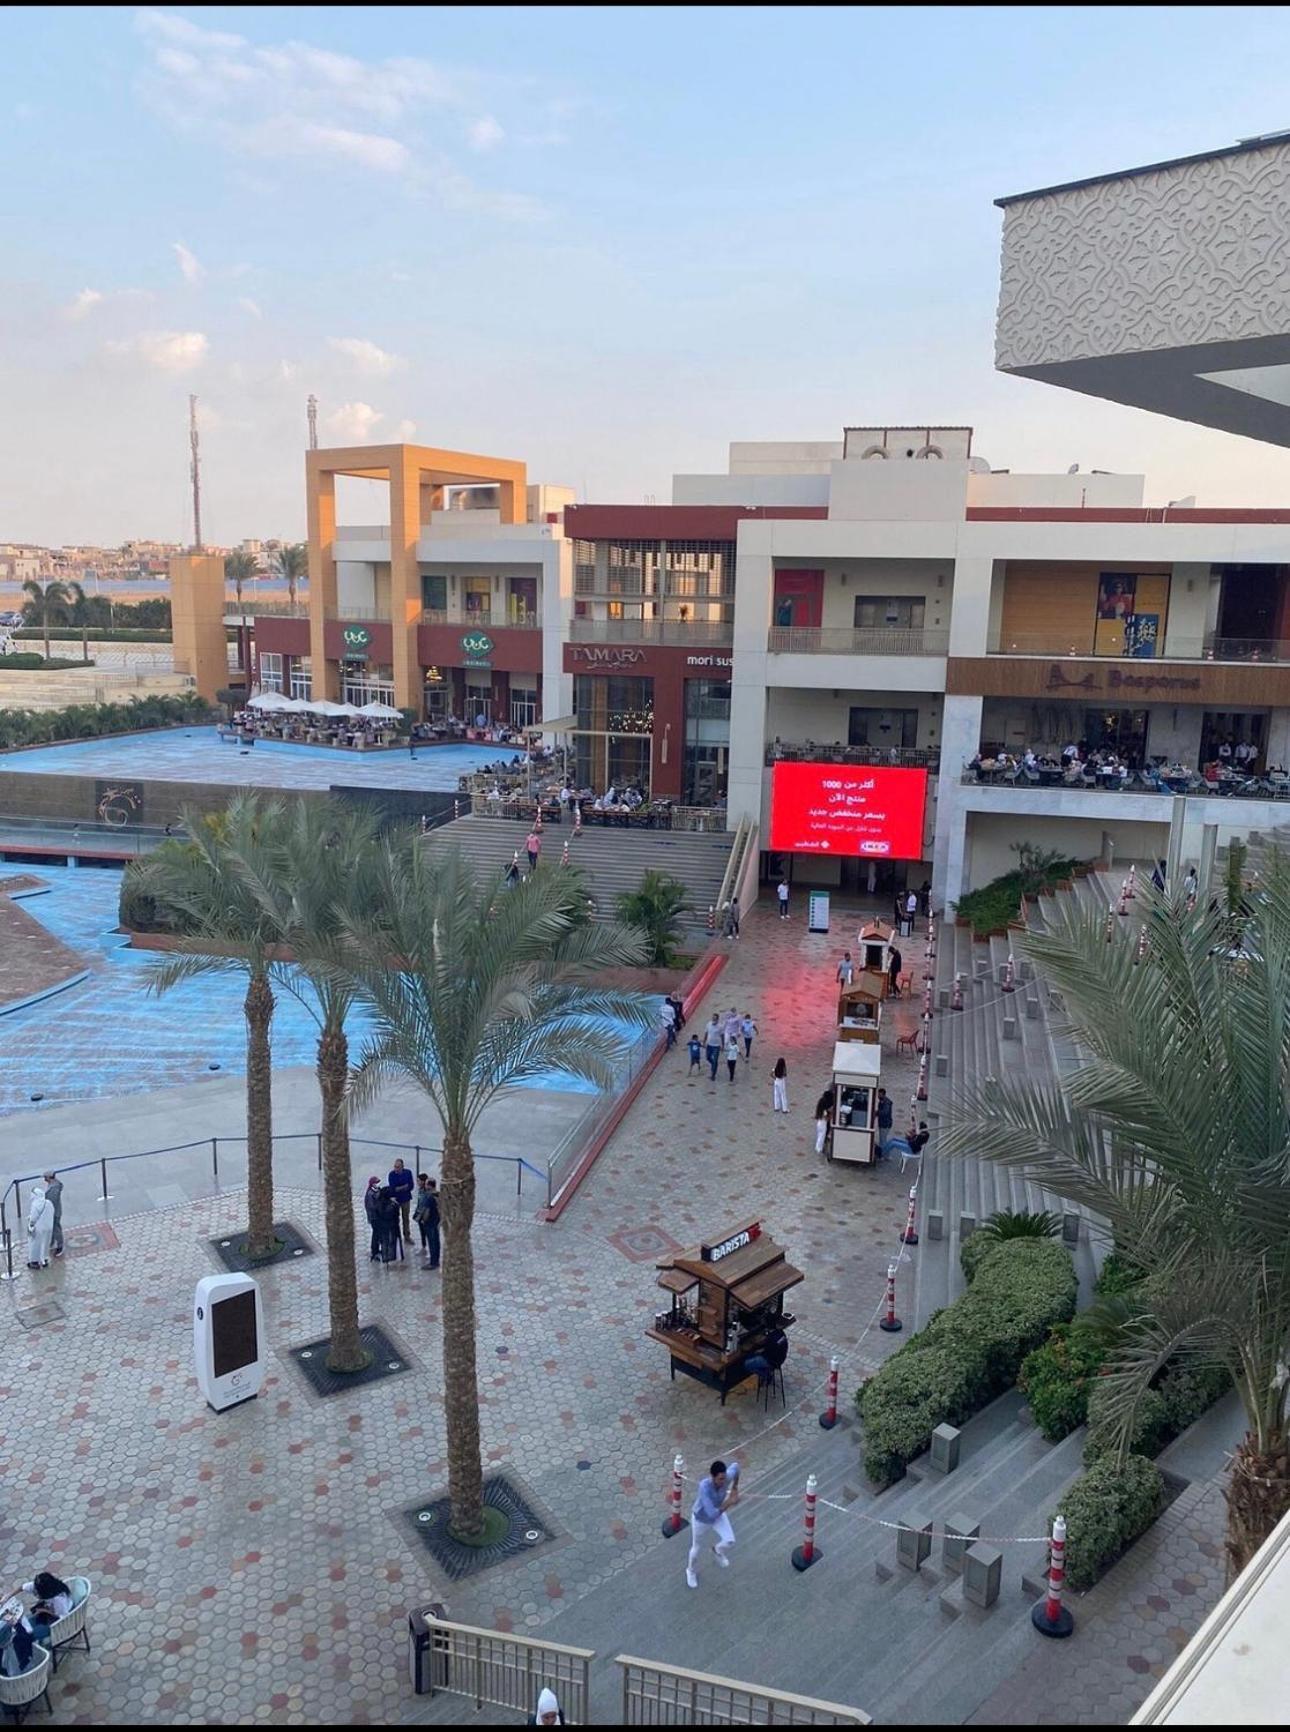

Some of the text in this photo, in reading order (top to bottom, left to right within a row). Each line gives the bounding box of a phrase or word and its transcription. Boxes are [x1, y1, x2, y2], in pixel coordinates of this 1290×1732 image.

[569, 648, 648, 662] TAMARA
[687, 655, 714, 666] mori
[822, 780, 842, 788] 1000
[843, 781, 857, 789] من
[710, 1230, 750, 1263] BARISTA
